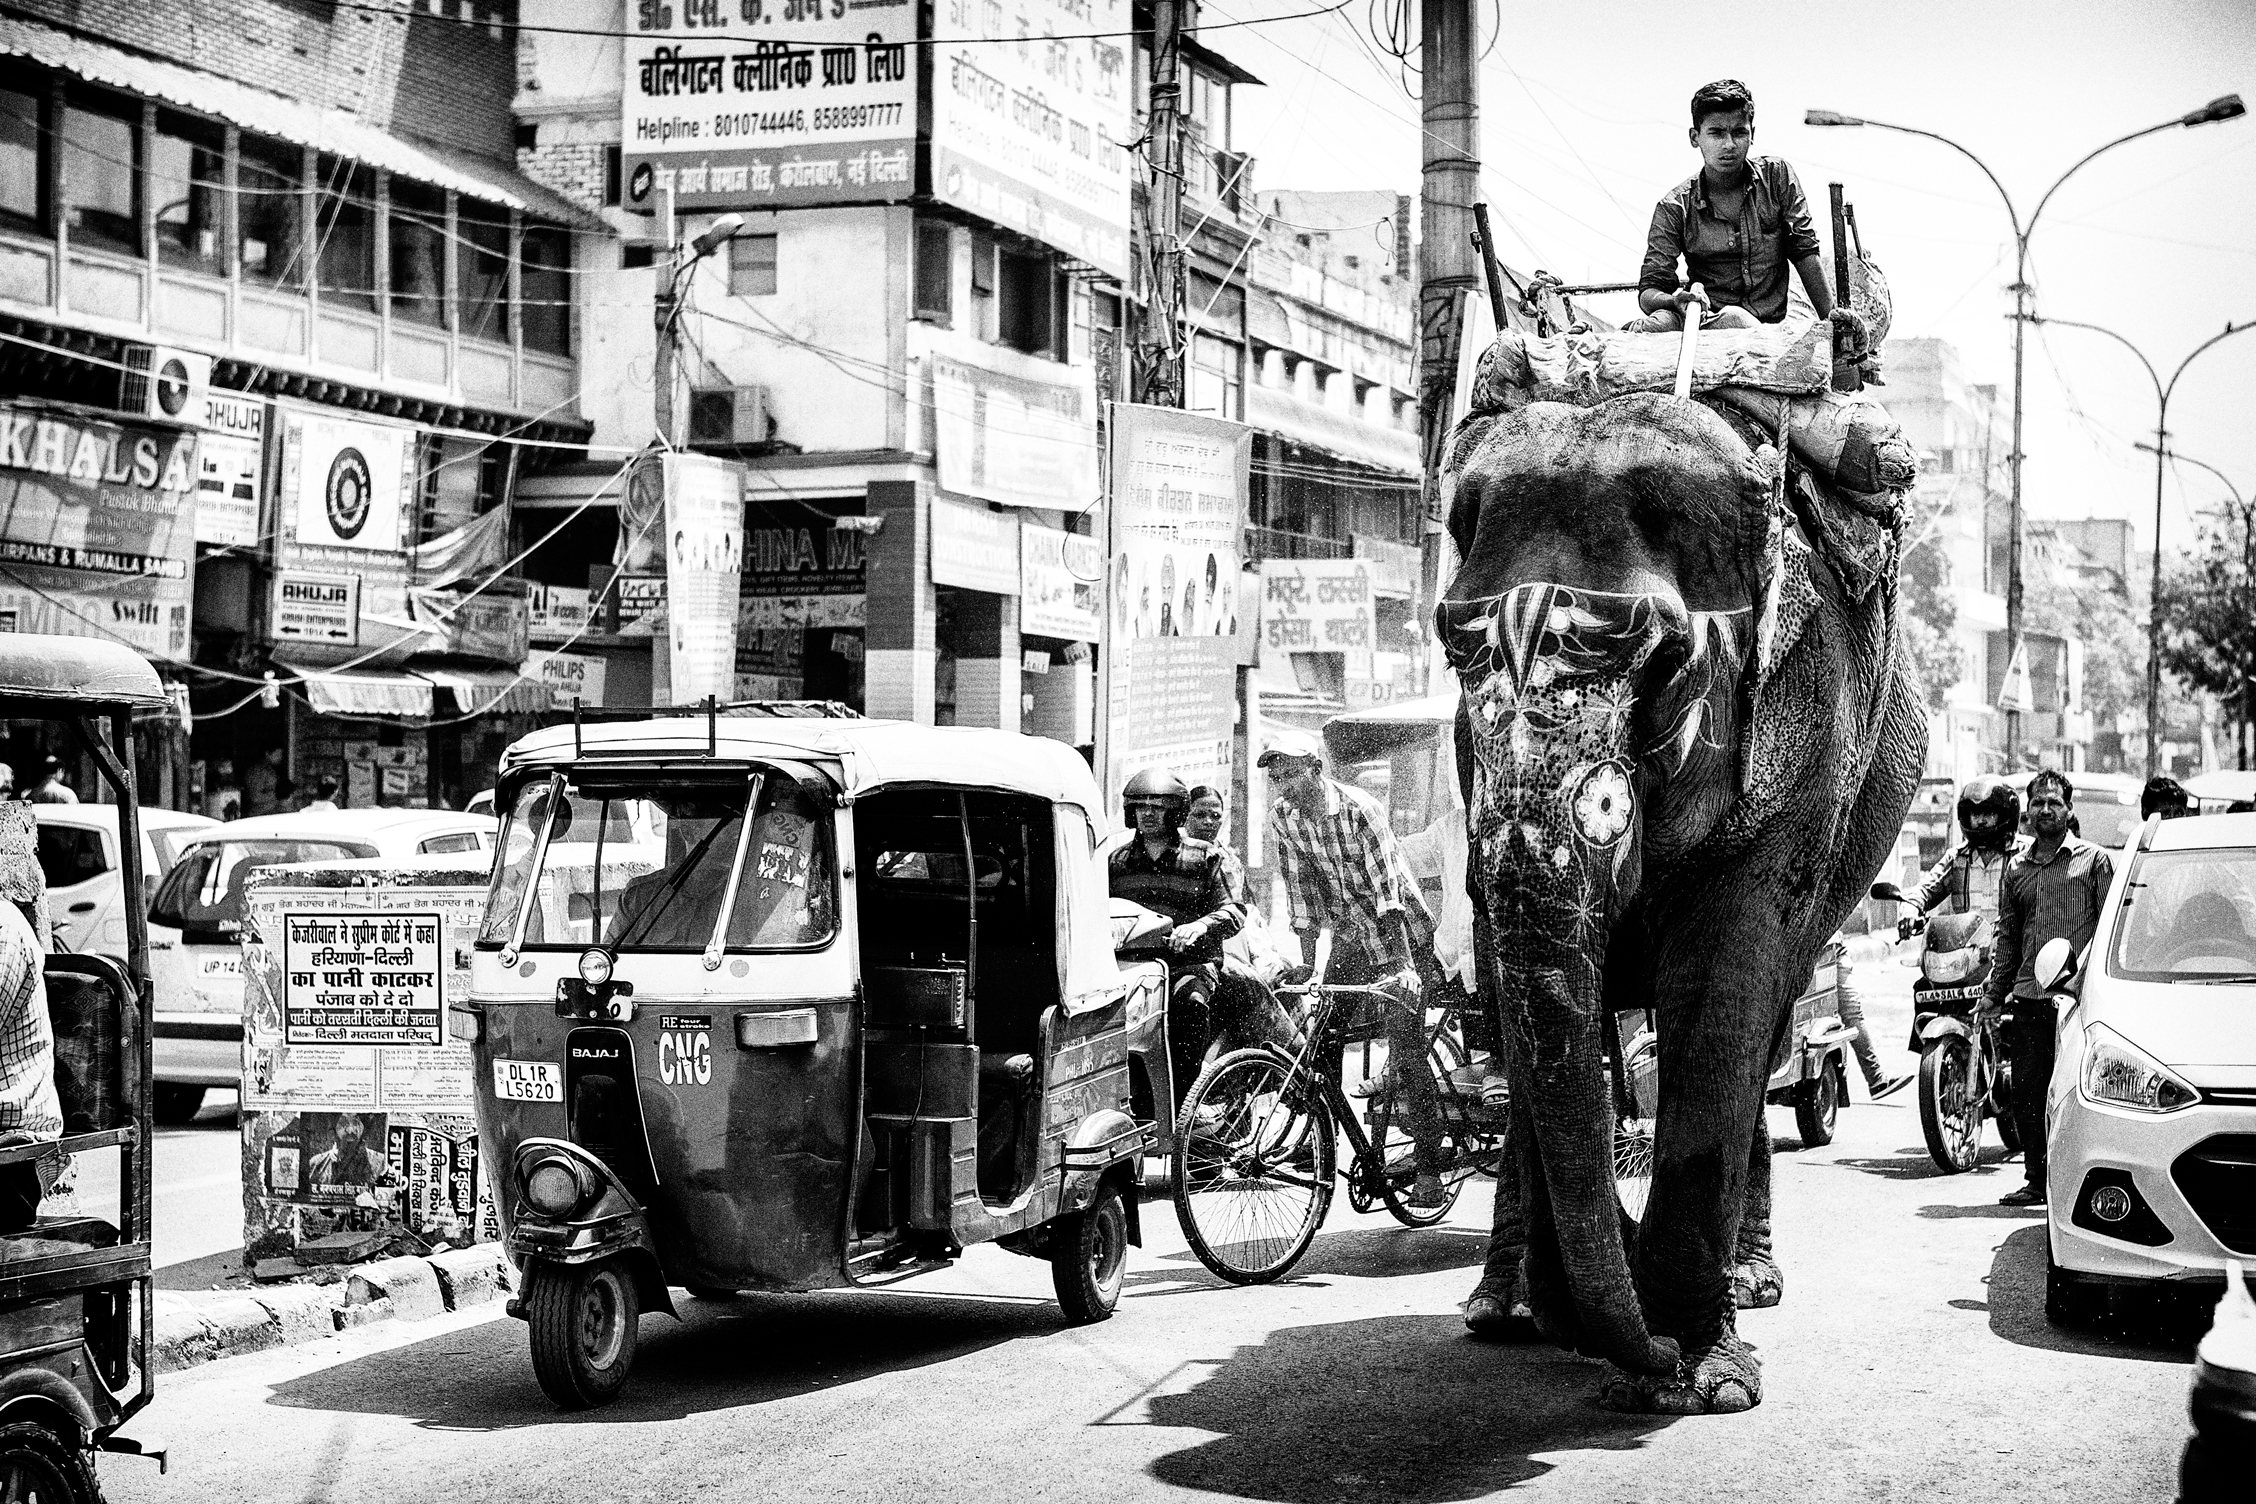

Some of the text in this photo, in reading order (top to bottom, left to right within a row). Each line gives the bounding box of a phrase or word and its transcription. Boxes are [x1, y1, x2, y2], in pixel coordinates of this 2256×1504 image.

[637, 116, 700, 144] Helpline
[714, 109, 809, 137] 8010744446,
[814, 102, 903, 130] 8588997777
[0, 410, 194, 492] KHALSA
[283, 584, 347, 602] AHUJA
[112, 600, 159, 625] Swift
[543, 660, 585, 680] PHILIPS
[1026, 658, 1046, 672] SALE
[290, 919, 435, 951] केजरीवाल ने सुप्रीम कोर्ट में कहा
[311, 947, 414, 966] हरियाणा-दिल्ली
[204, 961, 220, 973] UP
[224, 962, 235, 973] 14
[290, 971, 316, 987] का
[323, 967, 365, 987] पानी
[370, 971, 434, 988] काटकर
[316, 990, 414, 1006] पंजाब को दे दो
[290, 1008, 437, 1027] पानी को तरसती दिल्ली की जनता
[662, 1016, 678, 1028] RE
[315, 1027, 347, 1040] दिल्ली
[350, 1030, 394, 1040] मतदाता
[397, 1027, 434, 1043] परिषद्
[572, 1048, 619, 1058] BAJAJ
[659, 1031, 712, 1086] CNG
[506, 1081, 554, 1099] L5620
[413, 1132, 427, 1159] दिल्ली
[430, 1135, 447, 1183] अरविन्द
[413, 1162, 427, 1176] की
